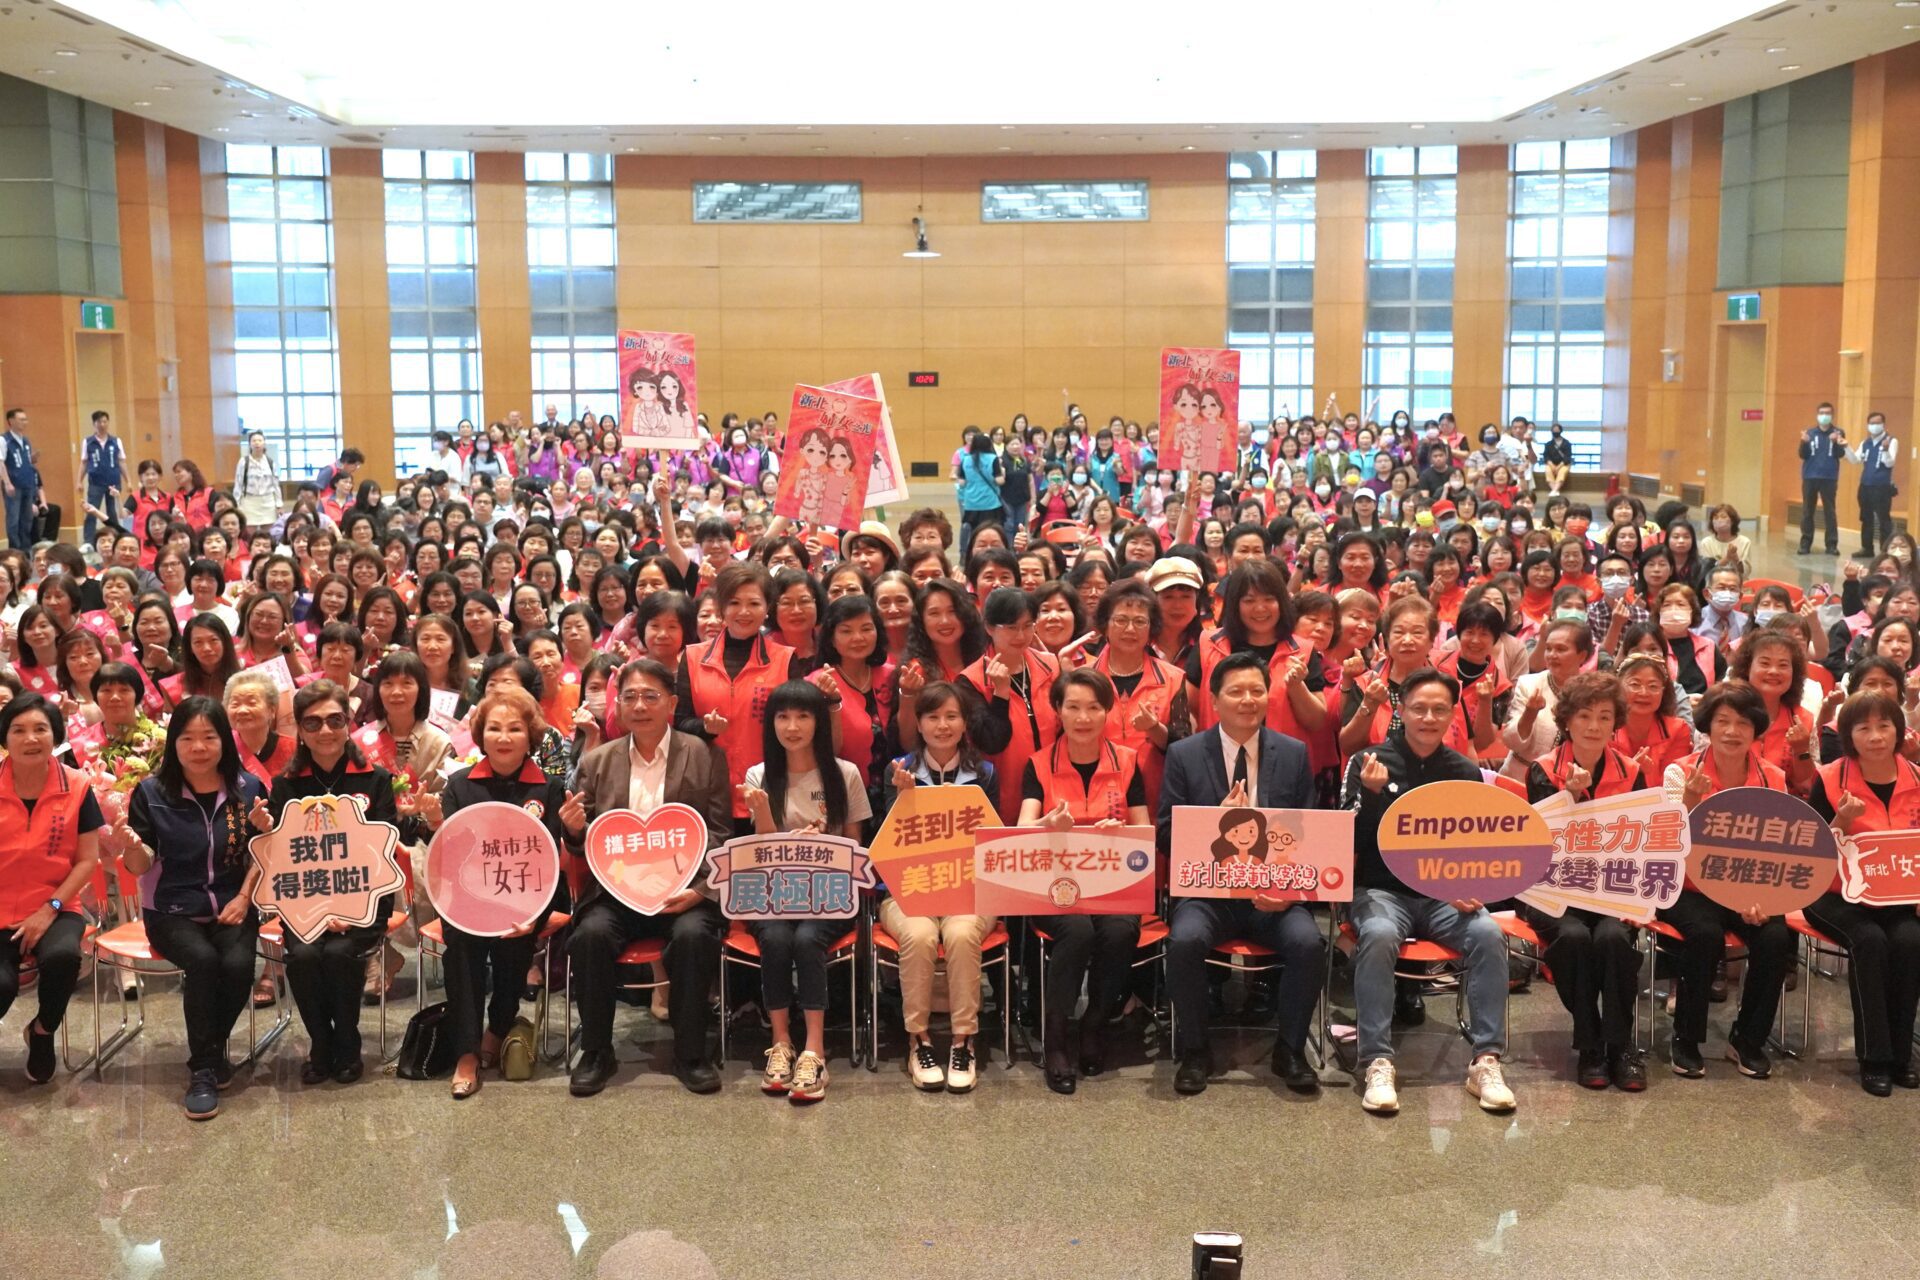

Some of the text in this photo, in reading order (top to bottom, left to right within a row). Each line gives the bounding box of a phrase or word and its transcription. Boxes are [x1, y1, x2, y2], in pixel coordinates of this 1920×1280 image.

[799, 392, 828, 411] 新北
[604, 828, 688, 856] 攜手同行
[893, 805, 986, 848] 活到老
[1396, 812, 1530, 841] Empower
[1703, 810, 1818, 848] 活出自信
[289, 832, 349, 865] 我們
[481, 834, 543, 857] 城市共
[754, 843, 834, 865] 新北挺妳
[982, 848, 1122, 874] 新北婦女之光
[272, 866, 370, 900] 得獎啦!
[482, 859, 543, 896] 「女子」
[1178, 860, 1318, 891] 新北模範婆媳
[1417, 857, 1521, 882] Women
[1700, 854, 1815, 890] 優雅到老
[729, 871, 855, 916] 展極限
